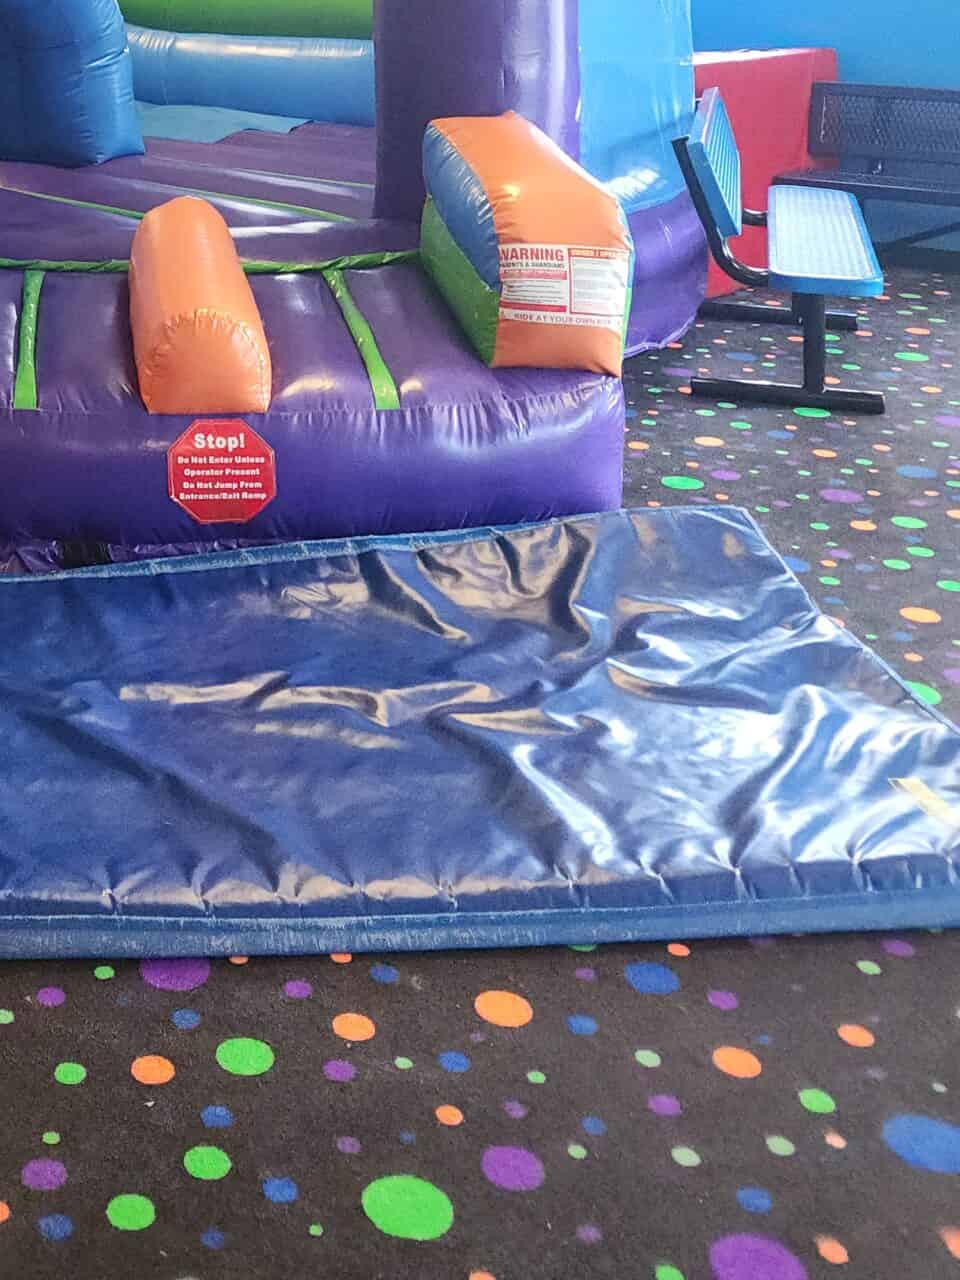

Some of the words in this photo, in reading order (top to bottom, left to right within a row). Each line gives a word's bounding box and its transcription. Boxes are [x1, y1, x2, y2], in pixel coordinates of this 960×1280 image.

[514, 312, 533, 321] RIDE
[535, 314, 547, 322] AT
[550, 315, 573, 323] YOUR
[193, 432, 245, 452] Stop!
[177, 455, 189, 464] Do
[191, 455, 207, 464] Not
[208, 455, 233, 464] Enter
[234, 455, 265, 464] Unless
[183, 468, 224, 477] Operator
[225, 467, 260, 476] Present
[183, 481, 195, 489] Do
[196, 481, 212, 489] Not
[214, 481, 238, 491] Jump
[239, 480, 262, 489] From
[179, 492, 240, 500] Entrance/Exit
[241, 491, 267, 501] Ramp
